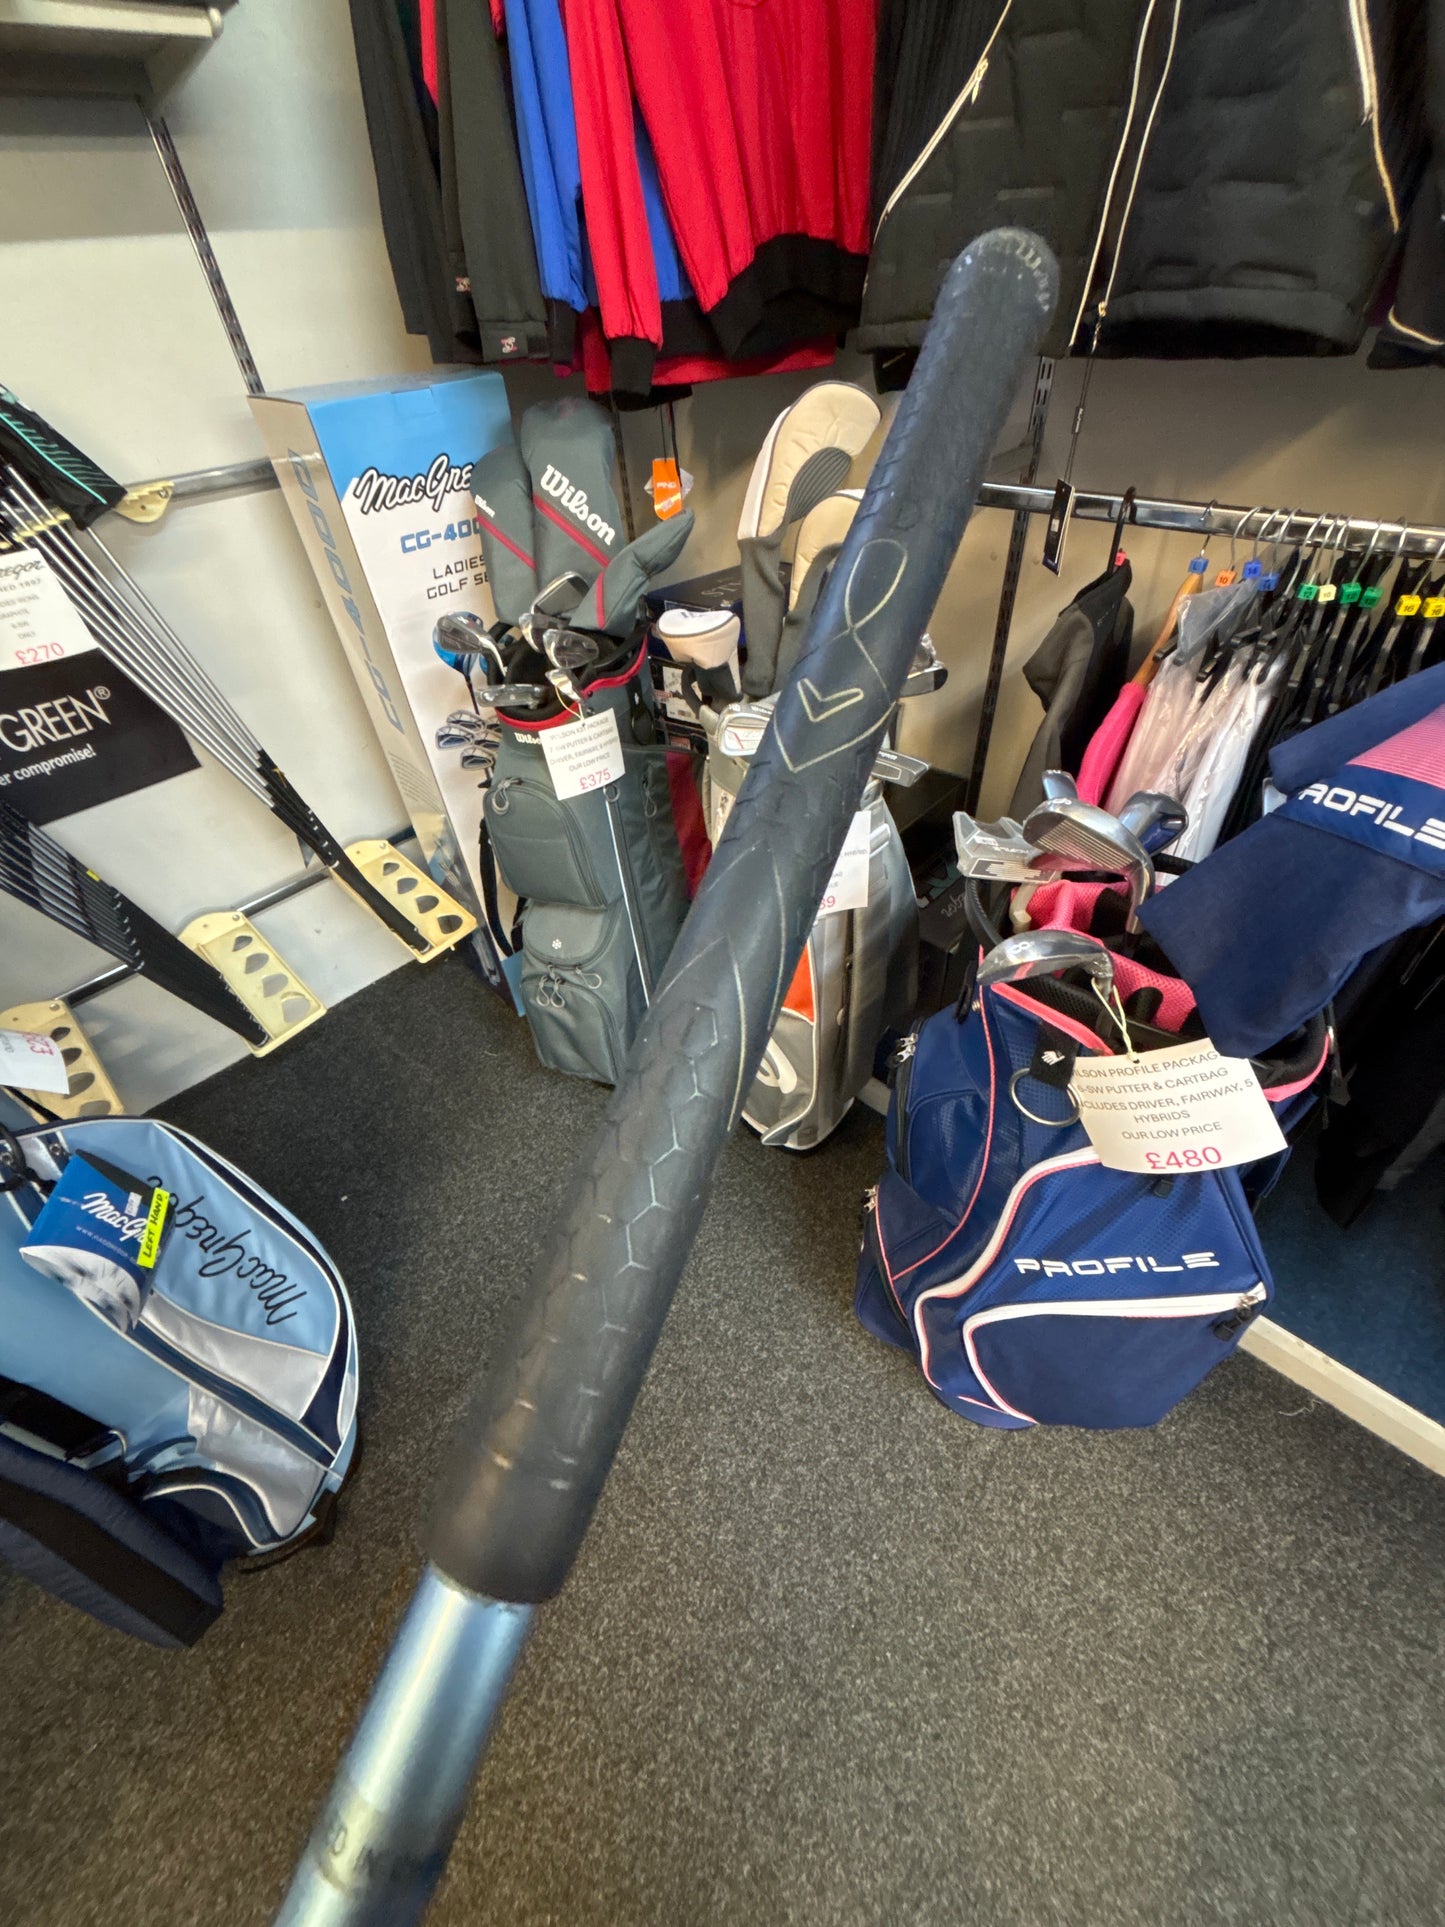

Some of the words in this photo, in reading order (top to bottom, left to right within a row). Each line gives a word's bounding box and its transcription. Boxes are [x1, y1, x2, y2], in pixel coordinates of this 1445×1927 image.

[540, 464, 616, 546] Wilson
[426, 578, 468, 599] GOLF
[1219, 575, 1228, 584] 10
[1431, 608, 1442, 616] 16
[16, 642, 64, 664] £270
[13, 743, 96, 775] compromise!
[579, 768, 611, 790] £375
[1298, 783, 1445, 850] ROFILE
[1110, 1064, 1161, 1077] PROFILE
[1163, 1050, 1220, 1071] PACKAG
[1106, 1081, 1151, 1095] PUTTER
[1152, 1081, 1163, 1090] &
[1166, 1067, 1229, 1088] CARTBAG
[1080, 1100, 1127, 1111] NCLUDES
[1129, 1097, 1180, 1111] DRIVER,
[1182, 1082, 1243, 1104] FAIRWAY,
[1245, 1078, 1254, 1088] 5
[1133, 1110, 1190, 1124] HYBRIDS
[1121, 1130, 1149, 1140] OUR
[1150, 1128, 1179, 1140] LOW
[1181, 1121, 1223, 1135] PRICE
[1145, 1146, 1222, 1170] £480
[150, 1193, 164, 1226] HAND
[142, 1228, 159, 1259] LEFT
[1014, 1251, 1220, 1276] PROFILE
